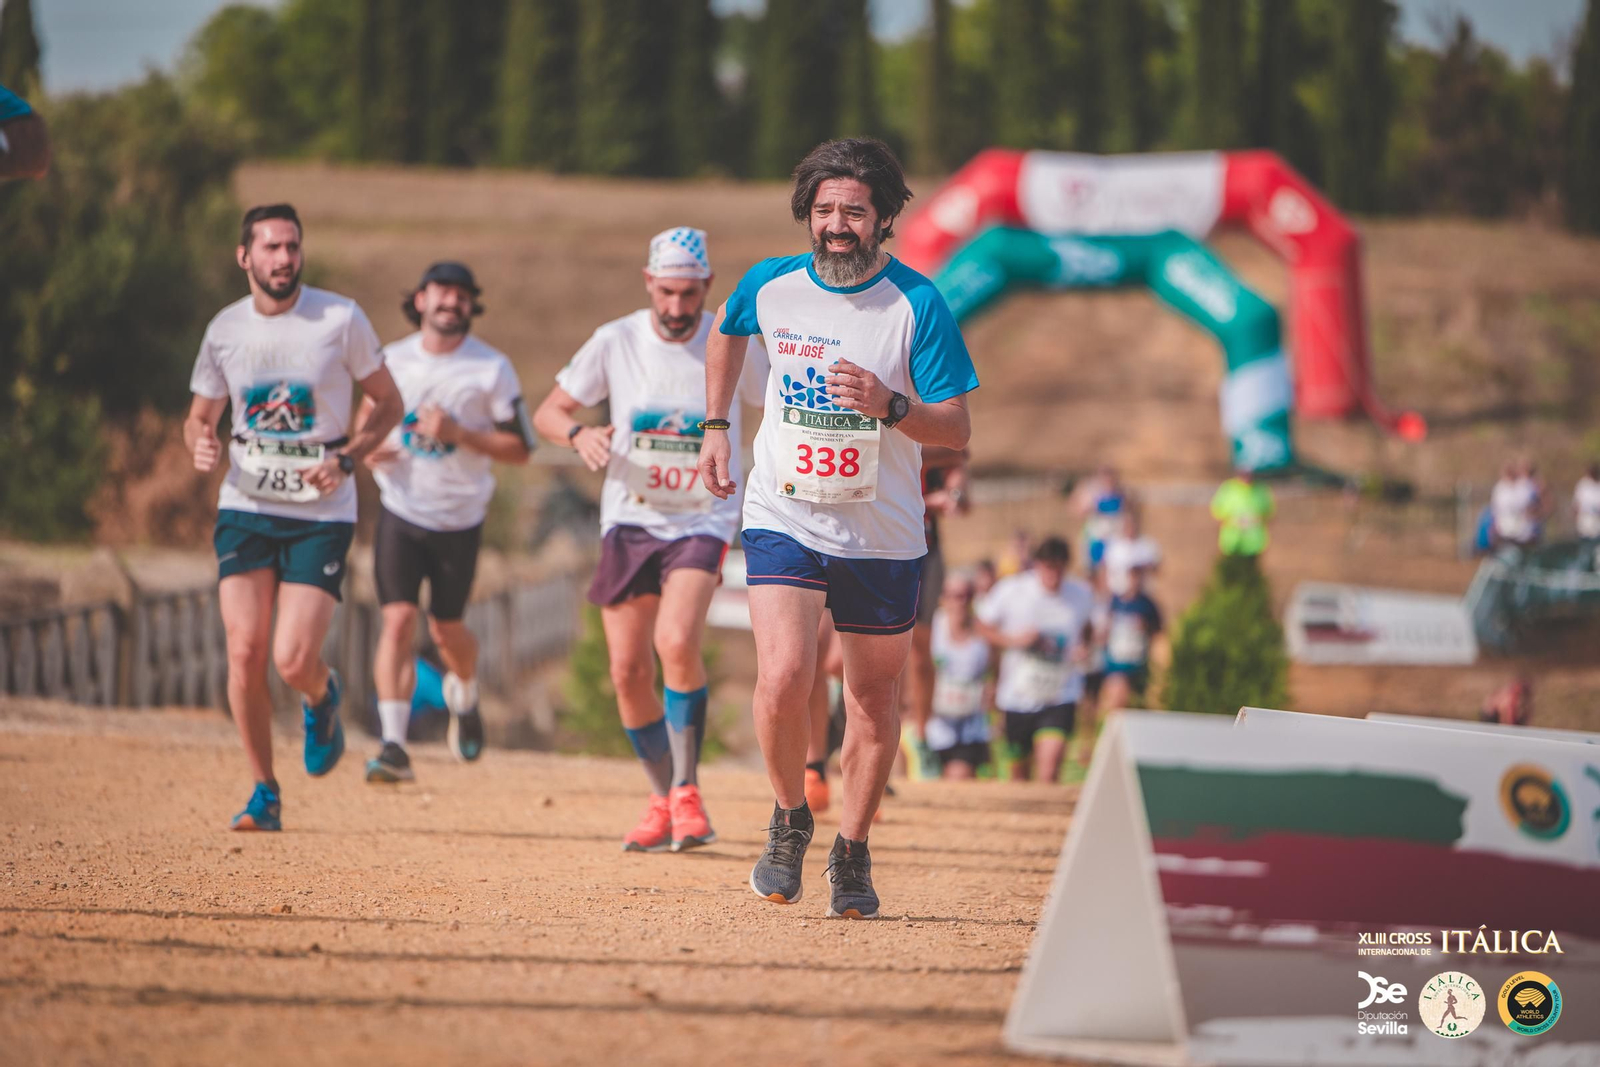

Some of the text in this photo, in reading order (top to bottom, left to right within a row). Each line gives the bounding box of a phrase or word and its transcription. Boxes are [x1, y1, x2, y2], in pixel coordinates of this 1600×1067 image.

[773, 331, 841, 346] CARRERA POPULAR
[778, 341, 825, 359] SAN JOSÉ
[805, 414, 851, 427] ITÁLICA
[796, 443, 860, 477] 338
[256, 467, 304, 493] 783
[647, 464, 699, 492] 307
